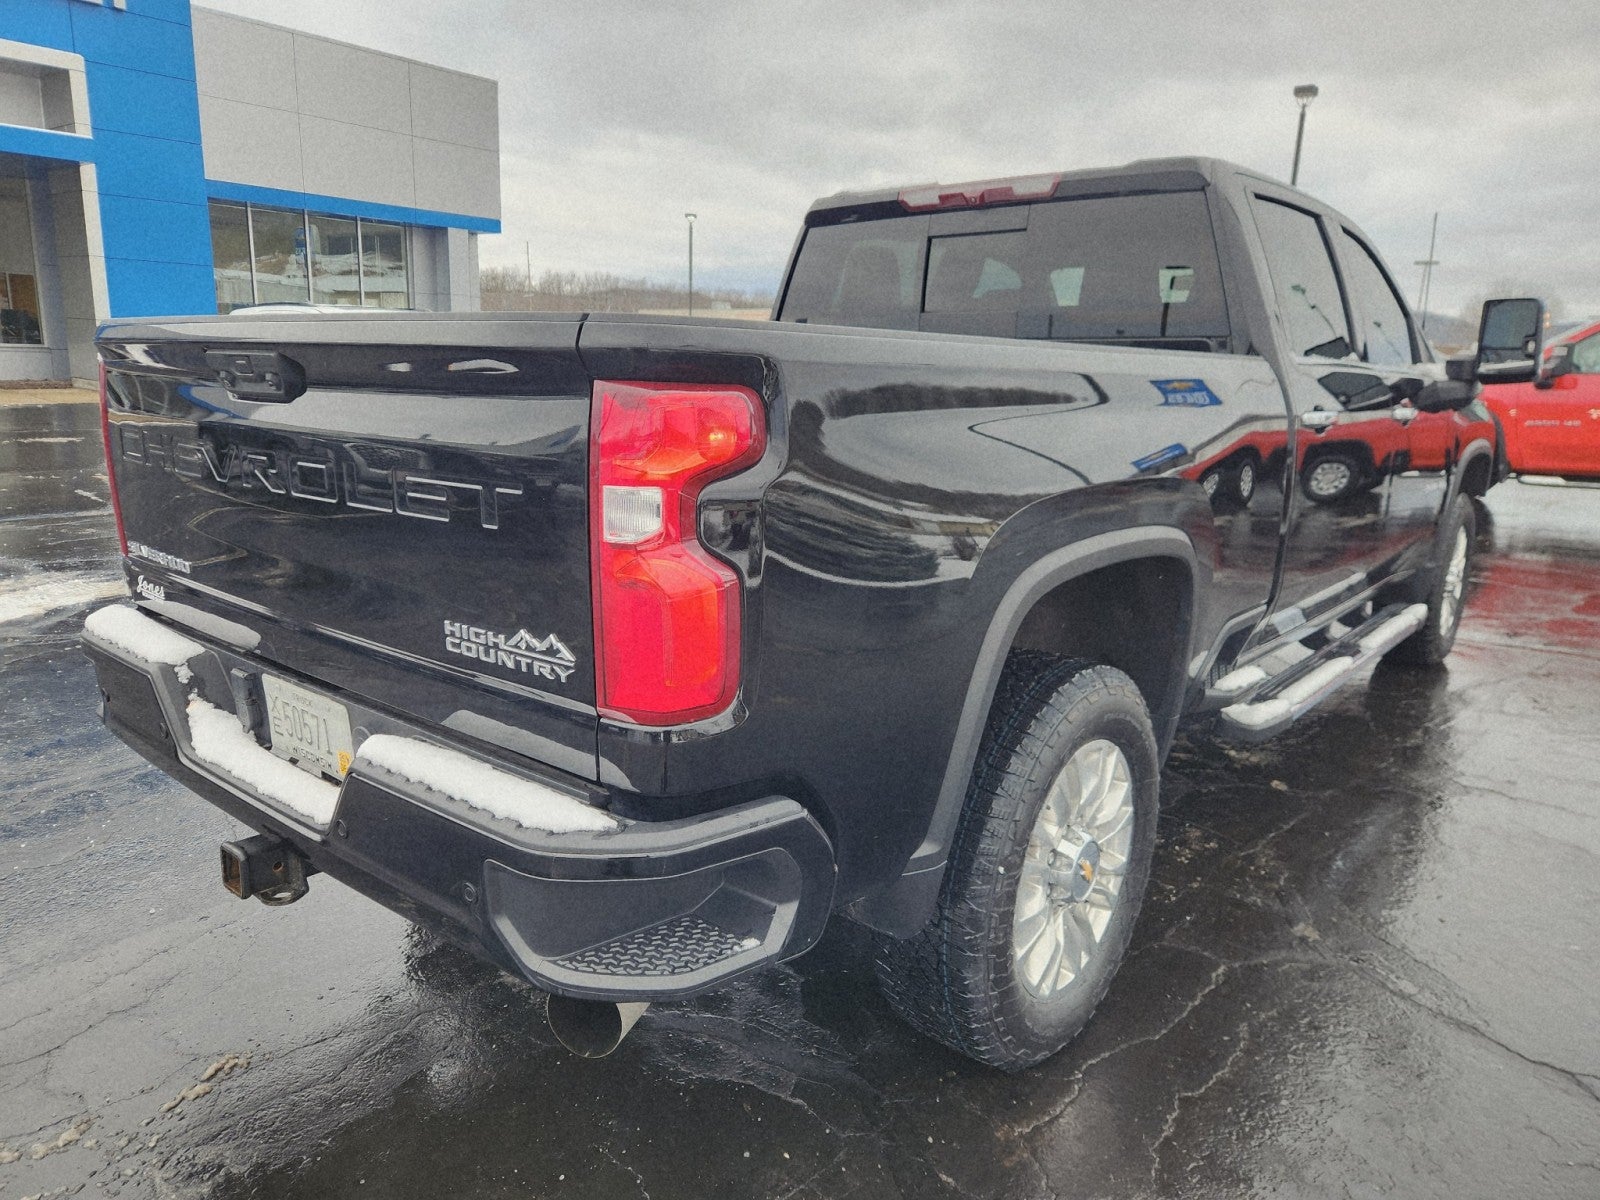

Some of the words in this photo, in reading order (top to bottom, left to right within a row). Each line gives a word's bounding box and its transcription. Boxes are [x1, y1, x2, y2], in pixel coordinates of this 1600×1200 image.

[118, 422, 523, 530] CHEVROLET
[136, 574, 166, 597] Jones
[443, 619, 507, 650] HIGH
[445, 636, 576, 683] COUNTRY
